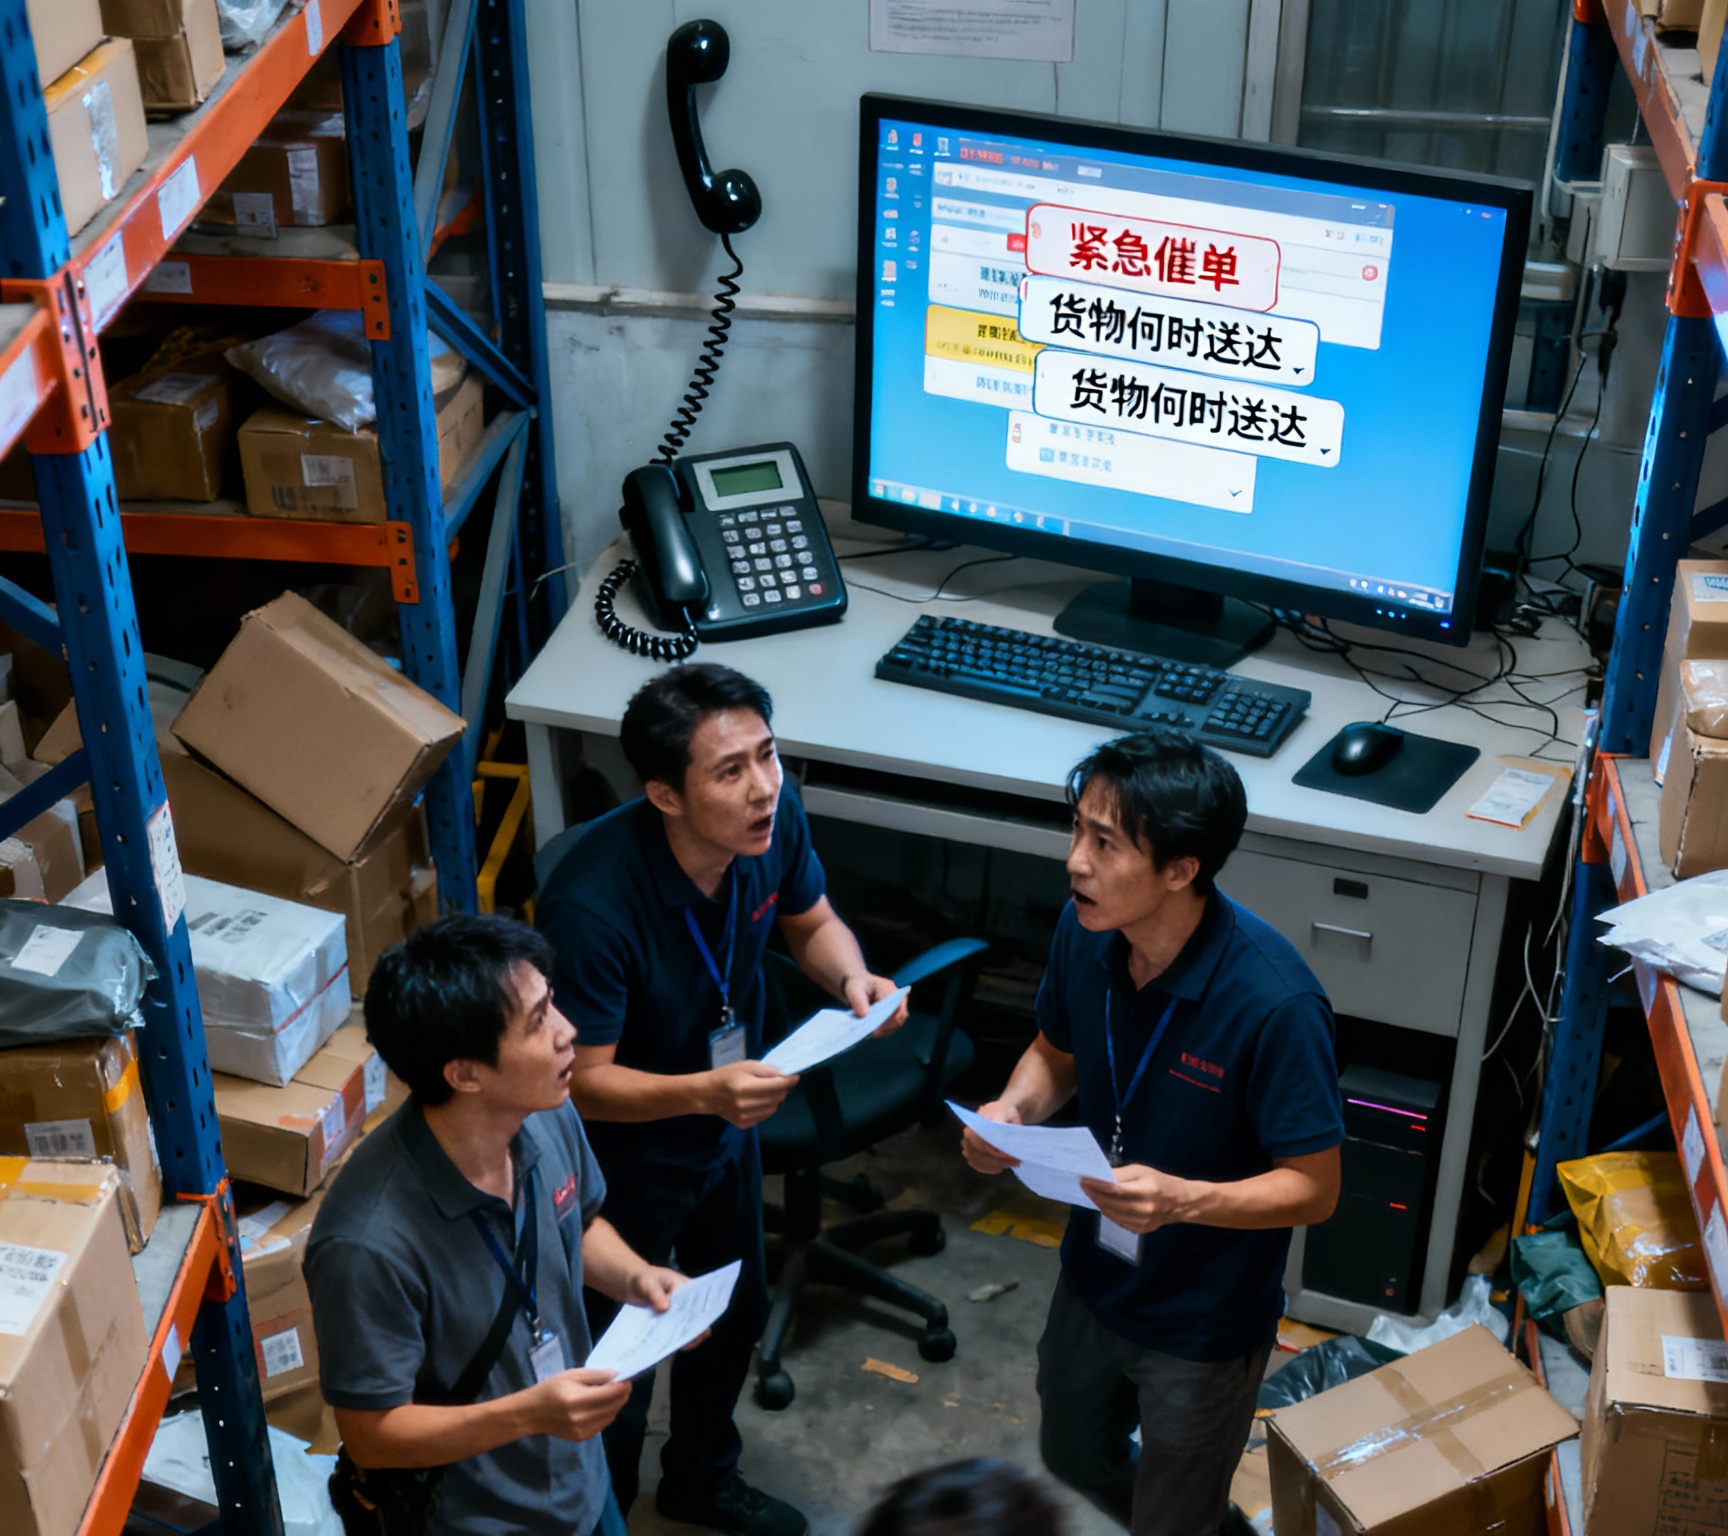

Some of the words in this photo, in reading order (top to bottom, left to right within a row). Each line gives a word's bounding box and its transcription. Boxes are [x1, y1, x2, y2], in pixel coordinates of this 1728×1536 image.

[1069, 222, 1240, 292] 紧急催单
[1049, 293, 1283, 370] 货物何时送达
[1070, 368, 1308, 448] 货物何时送达
